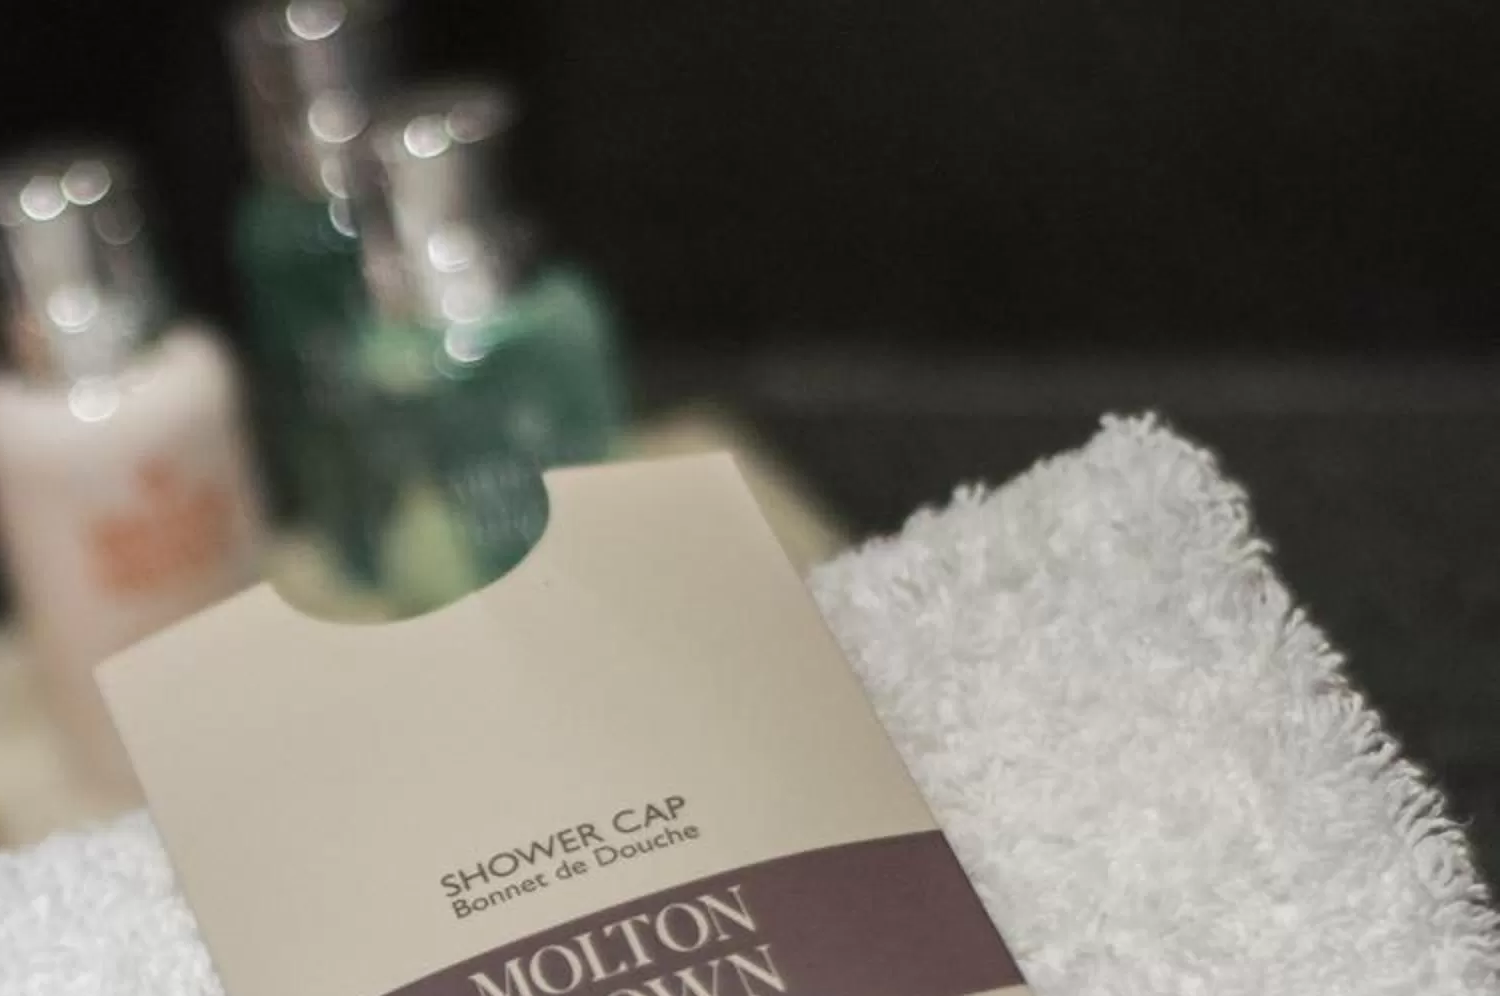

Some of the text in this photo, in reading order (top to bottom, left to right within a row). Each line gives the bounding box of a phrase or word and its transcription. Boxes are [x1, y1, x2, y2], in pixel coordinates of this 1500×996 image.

[440, 795, 686, 897] SHOWER CAP
[451, 825, 701, 919] Bonnet de Douche
